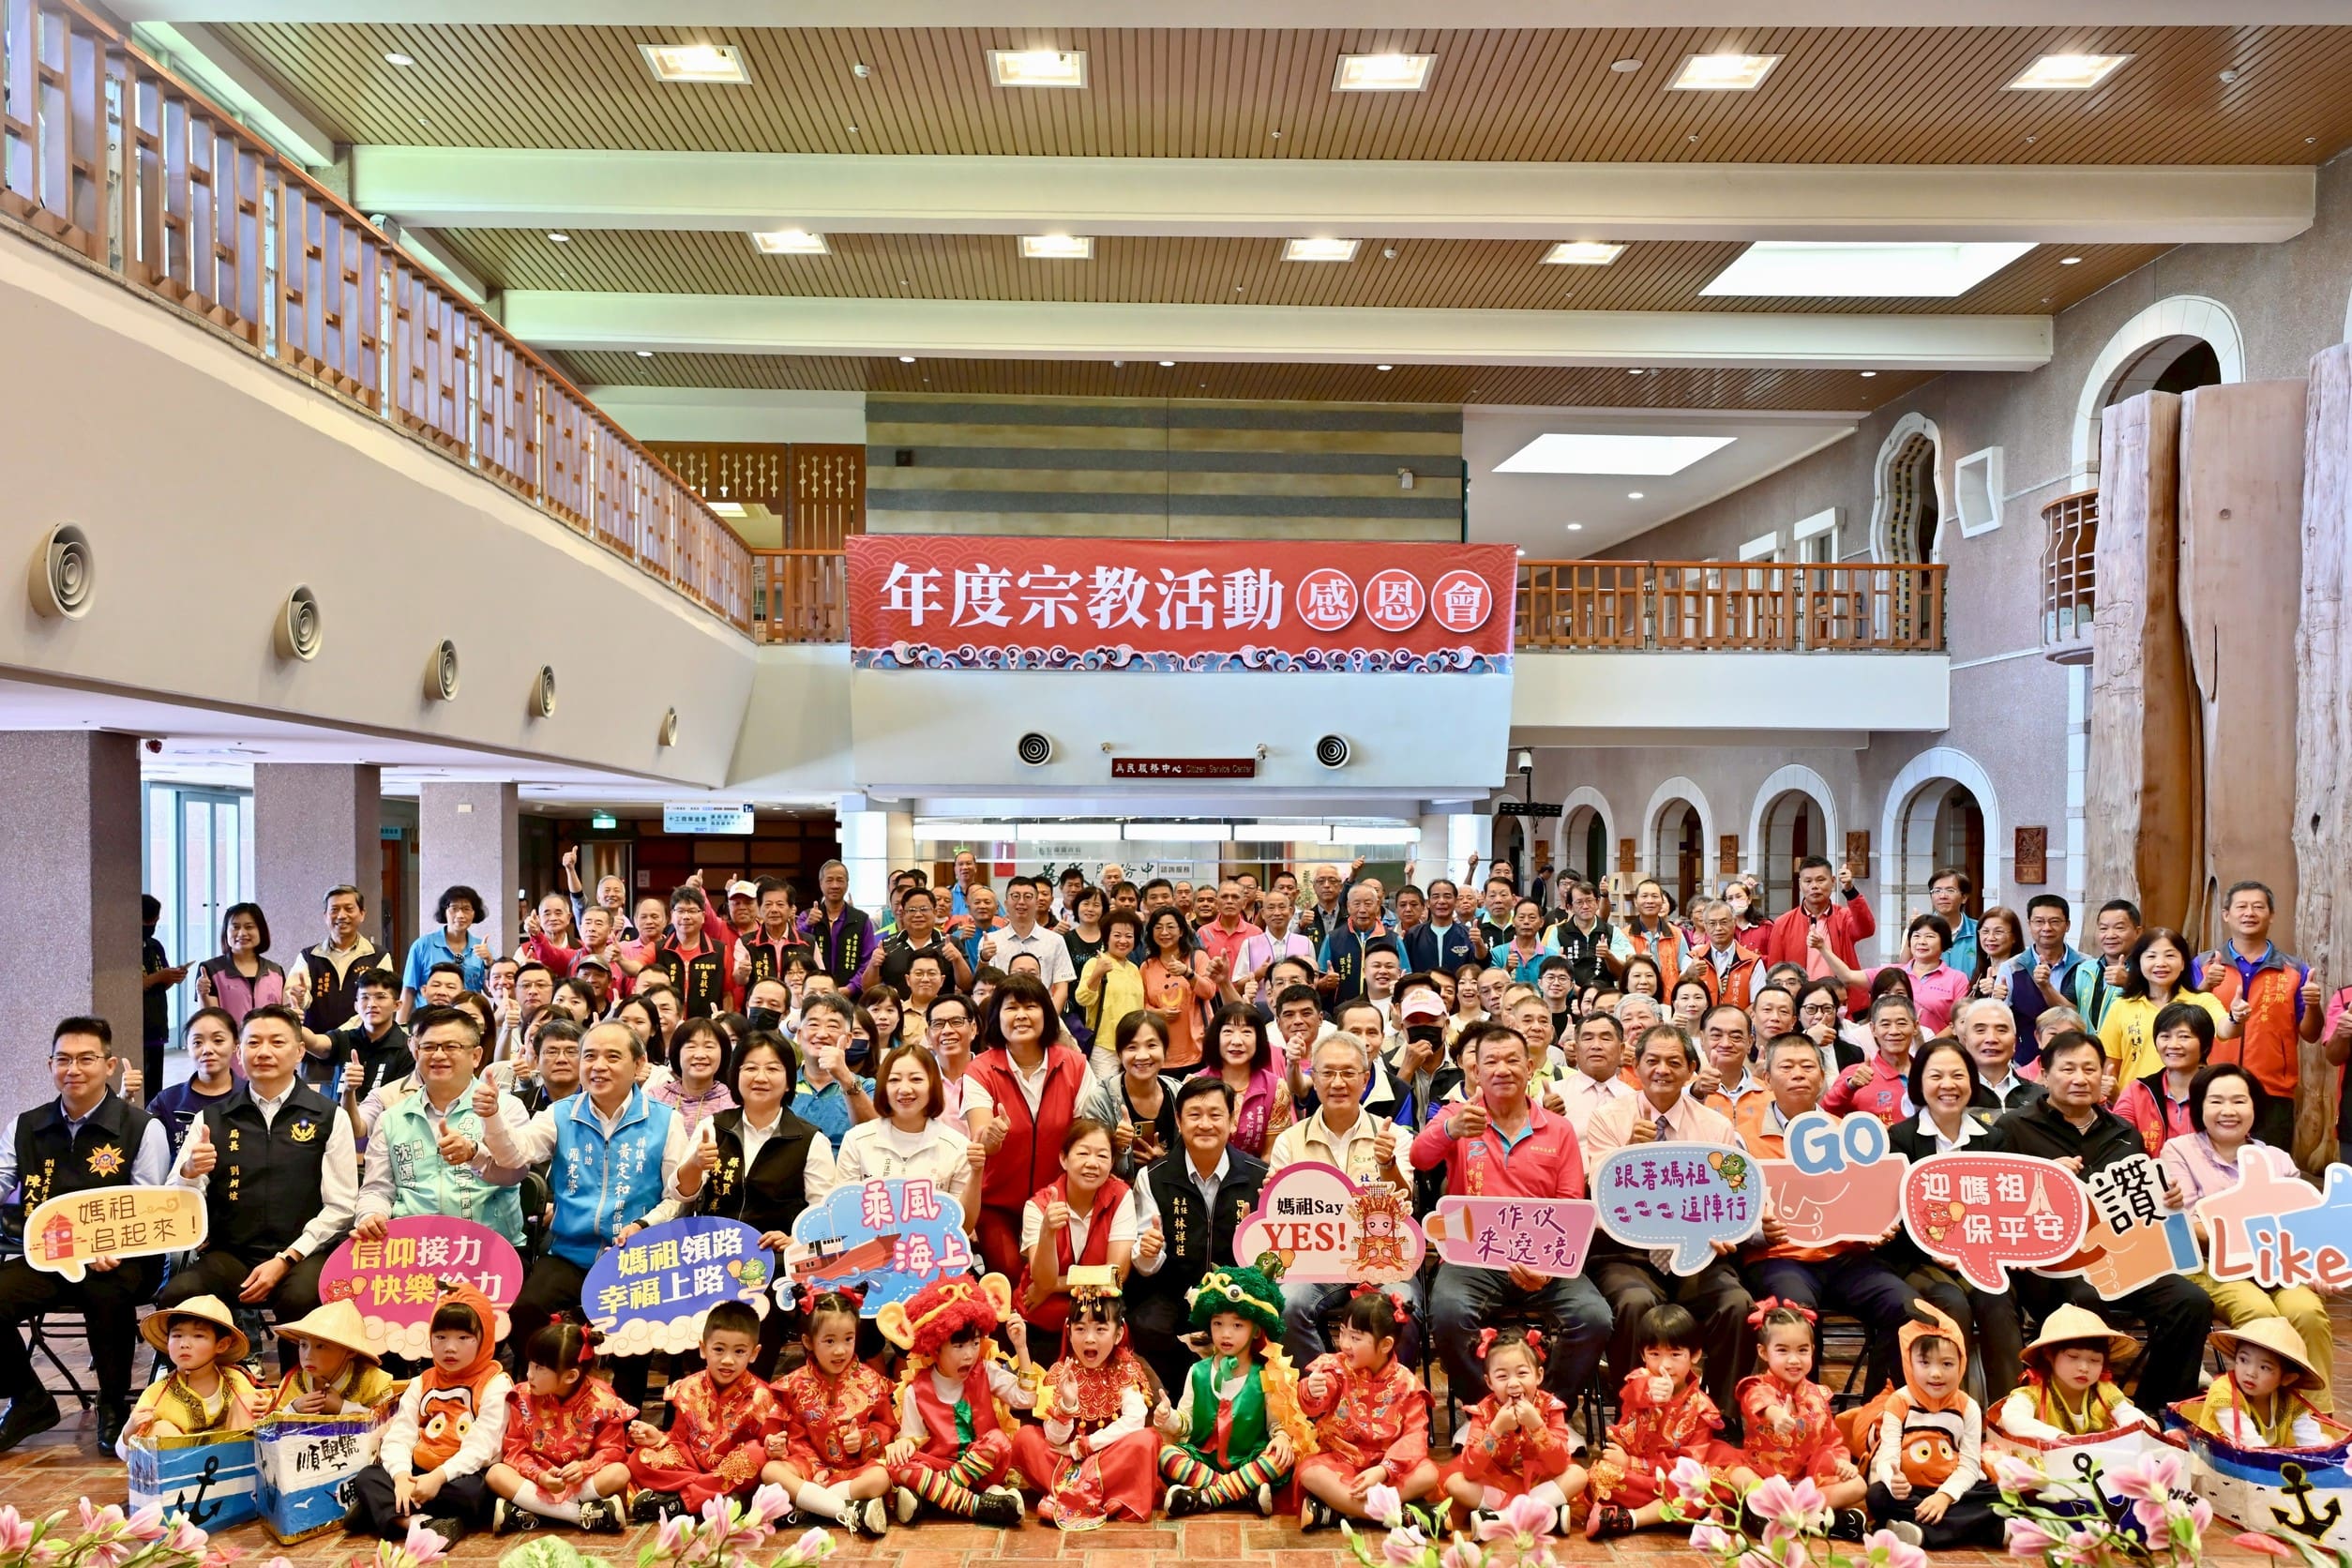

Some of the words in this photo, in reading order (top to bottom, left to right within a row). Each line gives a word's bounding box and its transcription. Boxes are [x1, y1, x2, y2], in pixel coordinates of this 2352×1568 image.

[1115, 762, 1183, 775] 為民服務中心
[1185, 764, 1206, 774] Citizen
[1209, 764, 1230, 774] Service
[1232, 764, 1252, 774] Center
[228, 1129, 240, 1153] 局長
[1789, 1116, 1885, 1175] GO
[1614, 1160, 1711, 1191] 跟著媽祖
[1920, 1171, 2028, 1206] 迎媽祖
[78, 1194, 138, 1226] 媽祖
[861, 1179, 942, 1230] 乘風
[1498, 1203, 1566, 1235] 作伙
[1681, 1194, 1747, 1225] 逗陣行
[1261, 1222, 1348, 1253] YES!
[1961, 1213, 2065, 1246] 保平安
[350, 1235, 483, 1270] 信仰接力
[617, 1227, 744, 1279] 媽祖領路
[893, 1232, 972, 1279] 海上
[1477, 1227, 1576, 1268] 來遶境
[2213, 1217, 2352, 1285] Like
[596, 1264, 725, 1315] 幸福上路
[296, 1435, 360, 1472] 順興號
